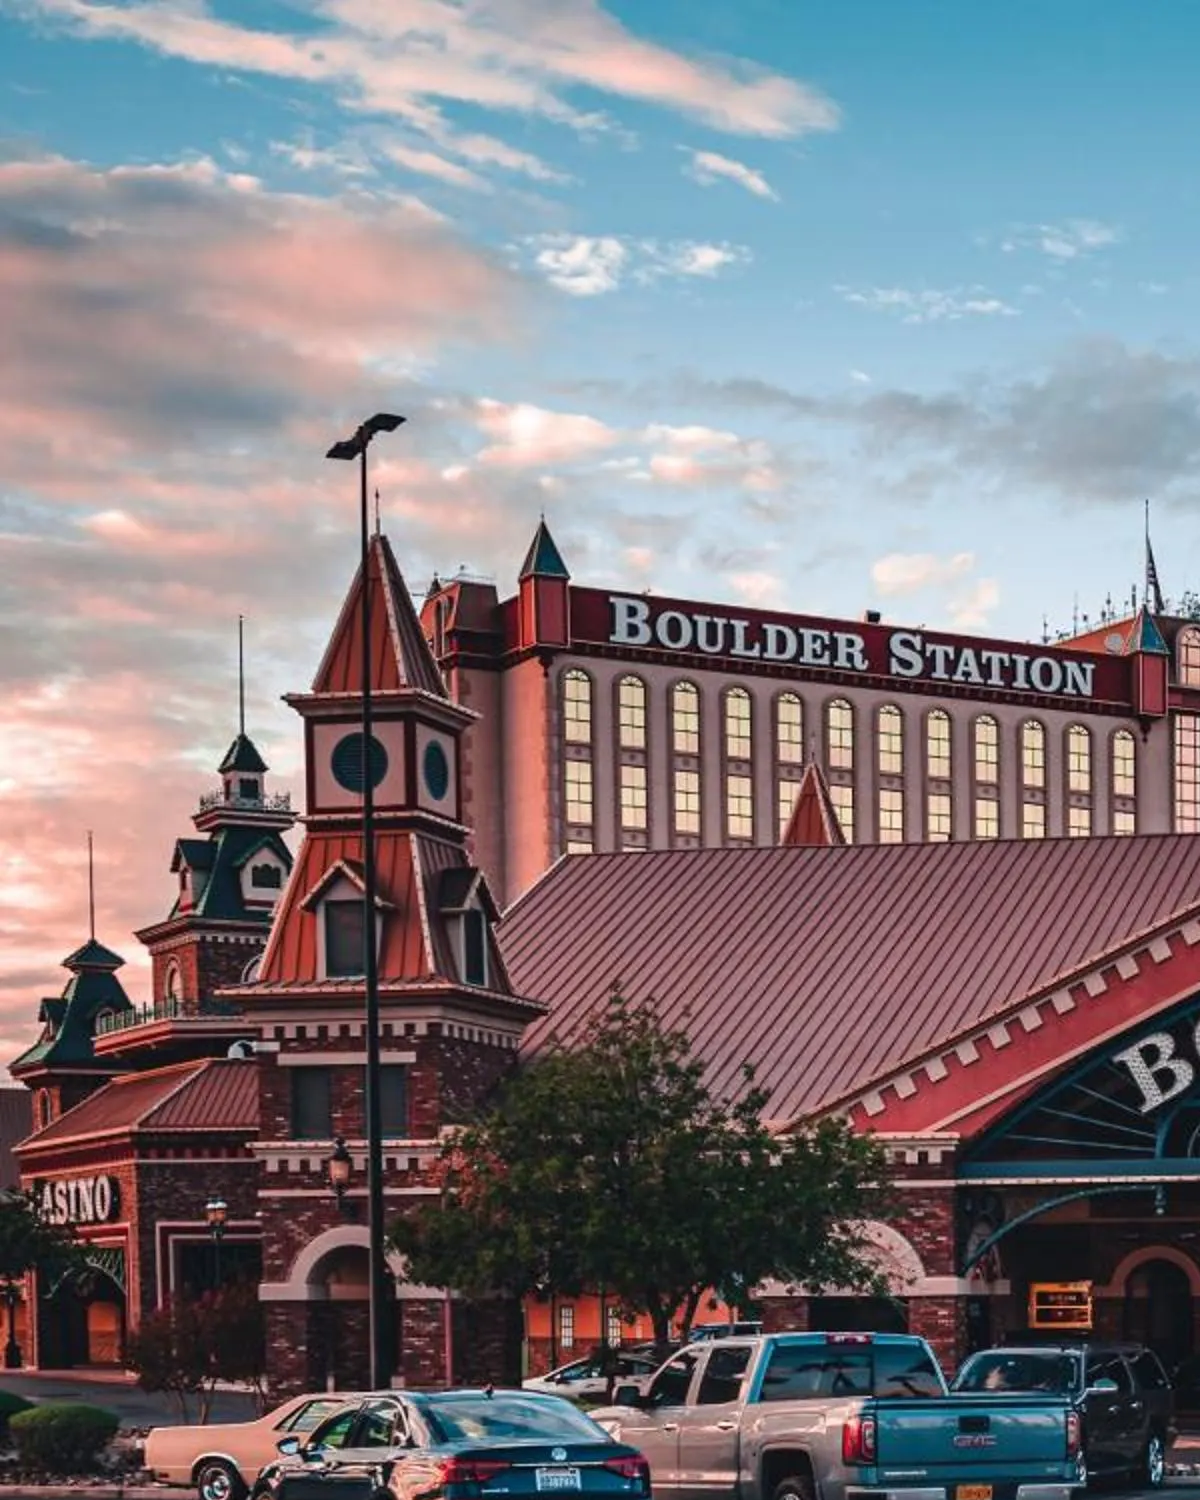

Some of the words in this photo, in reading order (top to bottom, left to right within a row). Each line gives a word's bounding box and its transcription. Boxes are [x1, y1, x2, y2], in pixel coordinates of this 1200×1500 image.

[609, 597, 869, 671] BOULDER
[889, 631, 1096, 697] STATION
[36, 1175, 111, 1225] ASINO
